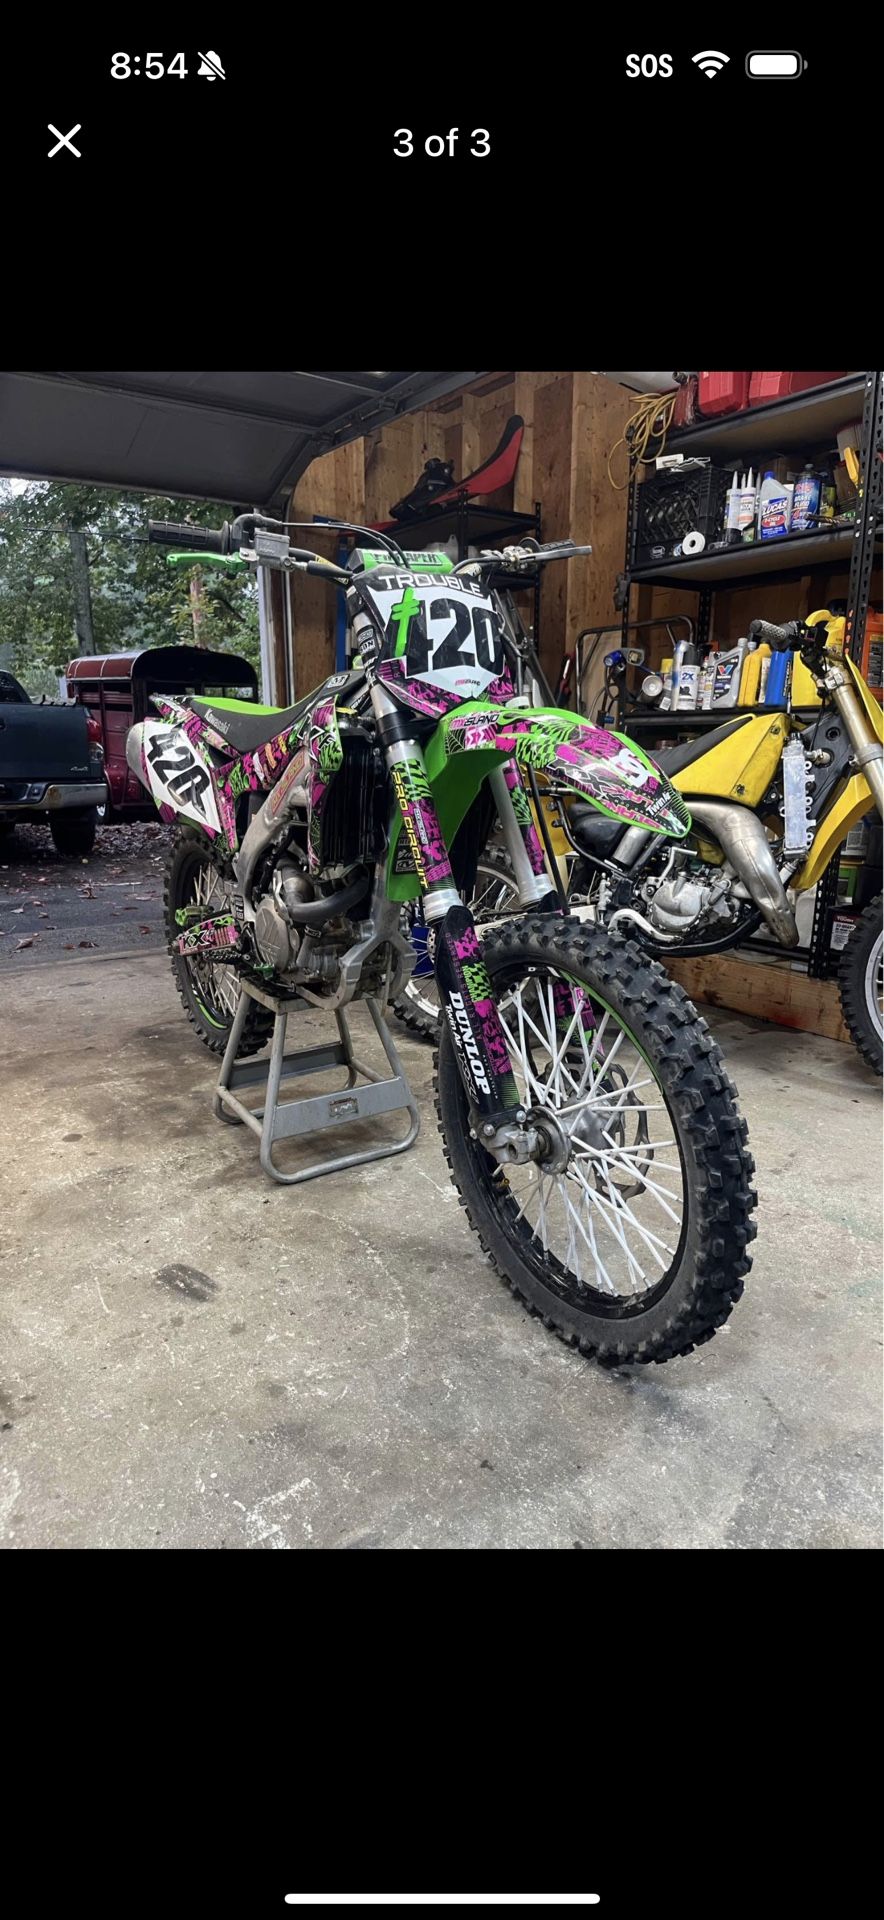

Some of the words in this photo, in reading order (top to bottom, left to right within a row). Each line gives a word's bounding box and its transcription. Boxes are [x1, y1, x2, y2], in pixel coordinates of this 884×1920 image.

[762, 501, 788, 515] LUCAS
[378, 573, 484, 598] TROUBLE
[383, 597, 505, 678] 420
[146, 731, 211, 807] 420
[392, 771, 409, 811] PRO
[403, 816, 430, 889] CIRCUIT
[445, 1003, 458, 1030] Twin
[453, 1031, 463, 1049] Air
[448, 990, 492, 1095] DUNLOP
